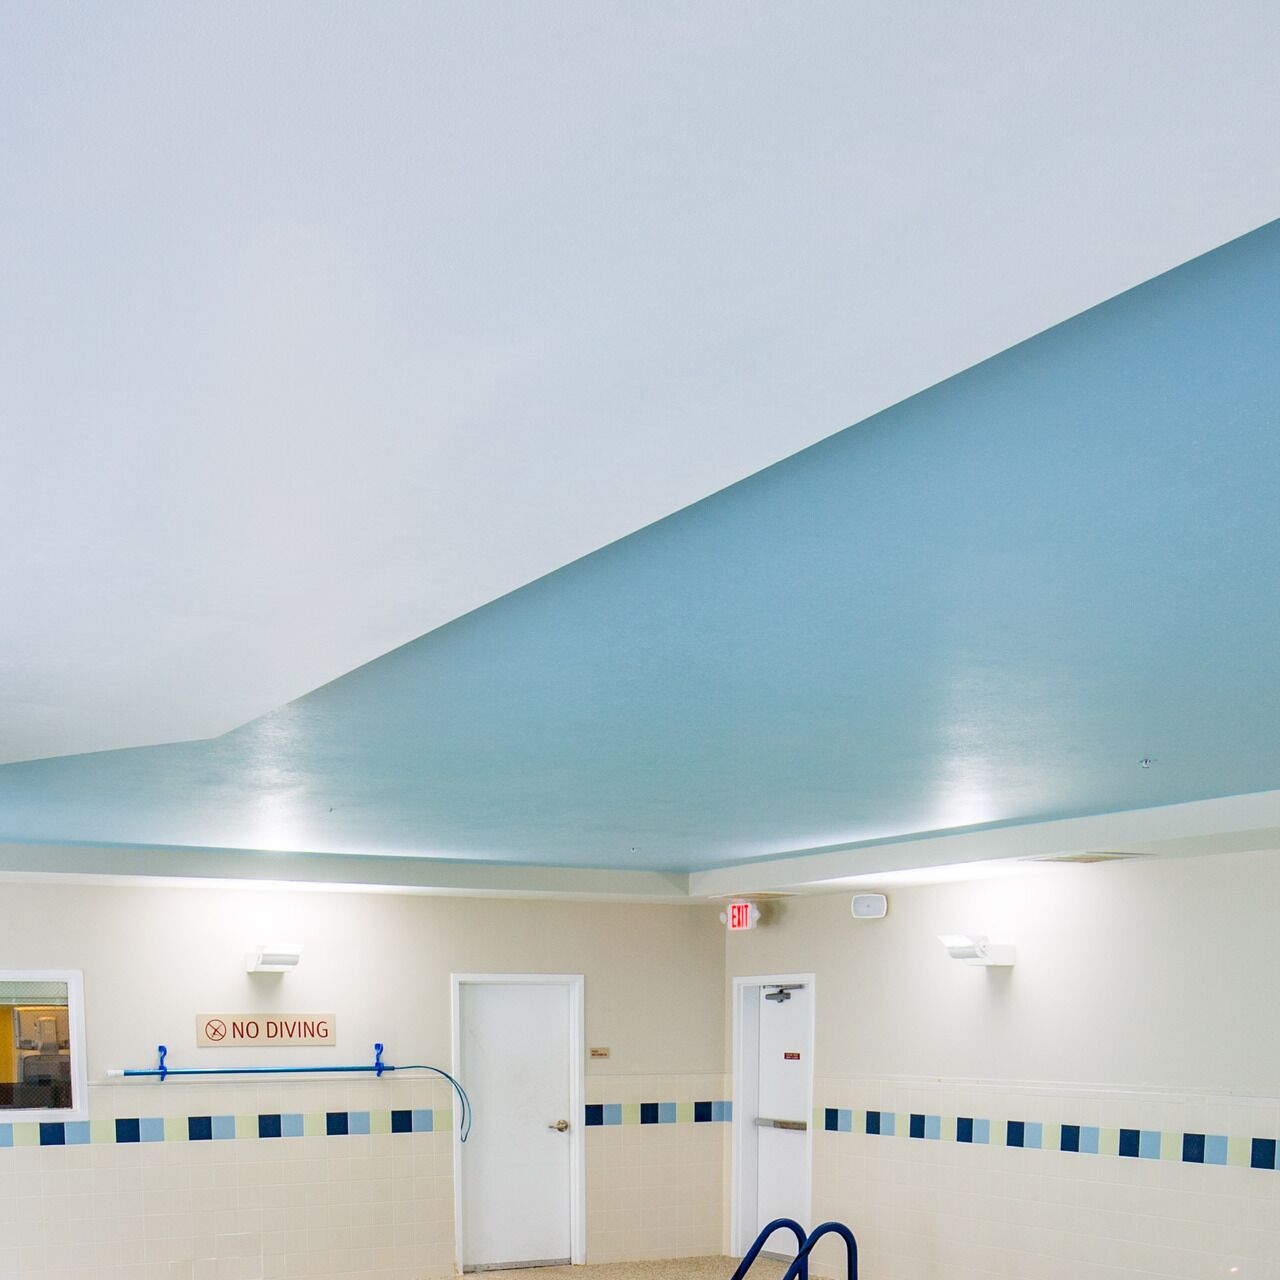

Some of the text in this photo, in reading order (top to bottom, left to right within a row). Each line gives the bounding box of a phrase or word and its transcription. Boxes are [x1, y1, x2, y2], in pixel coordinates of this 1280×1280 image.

[731, 904, 750, 928] EXIT
[231, 1021, 329, 1039] NO DIVING
